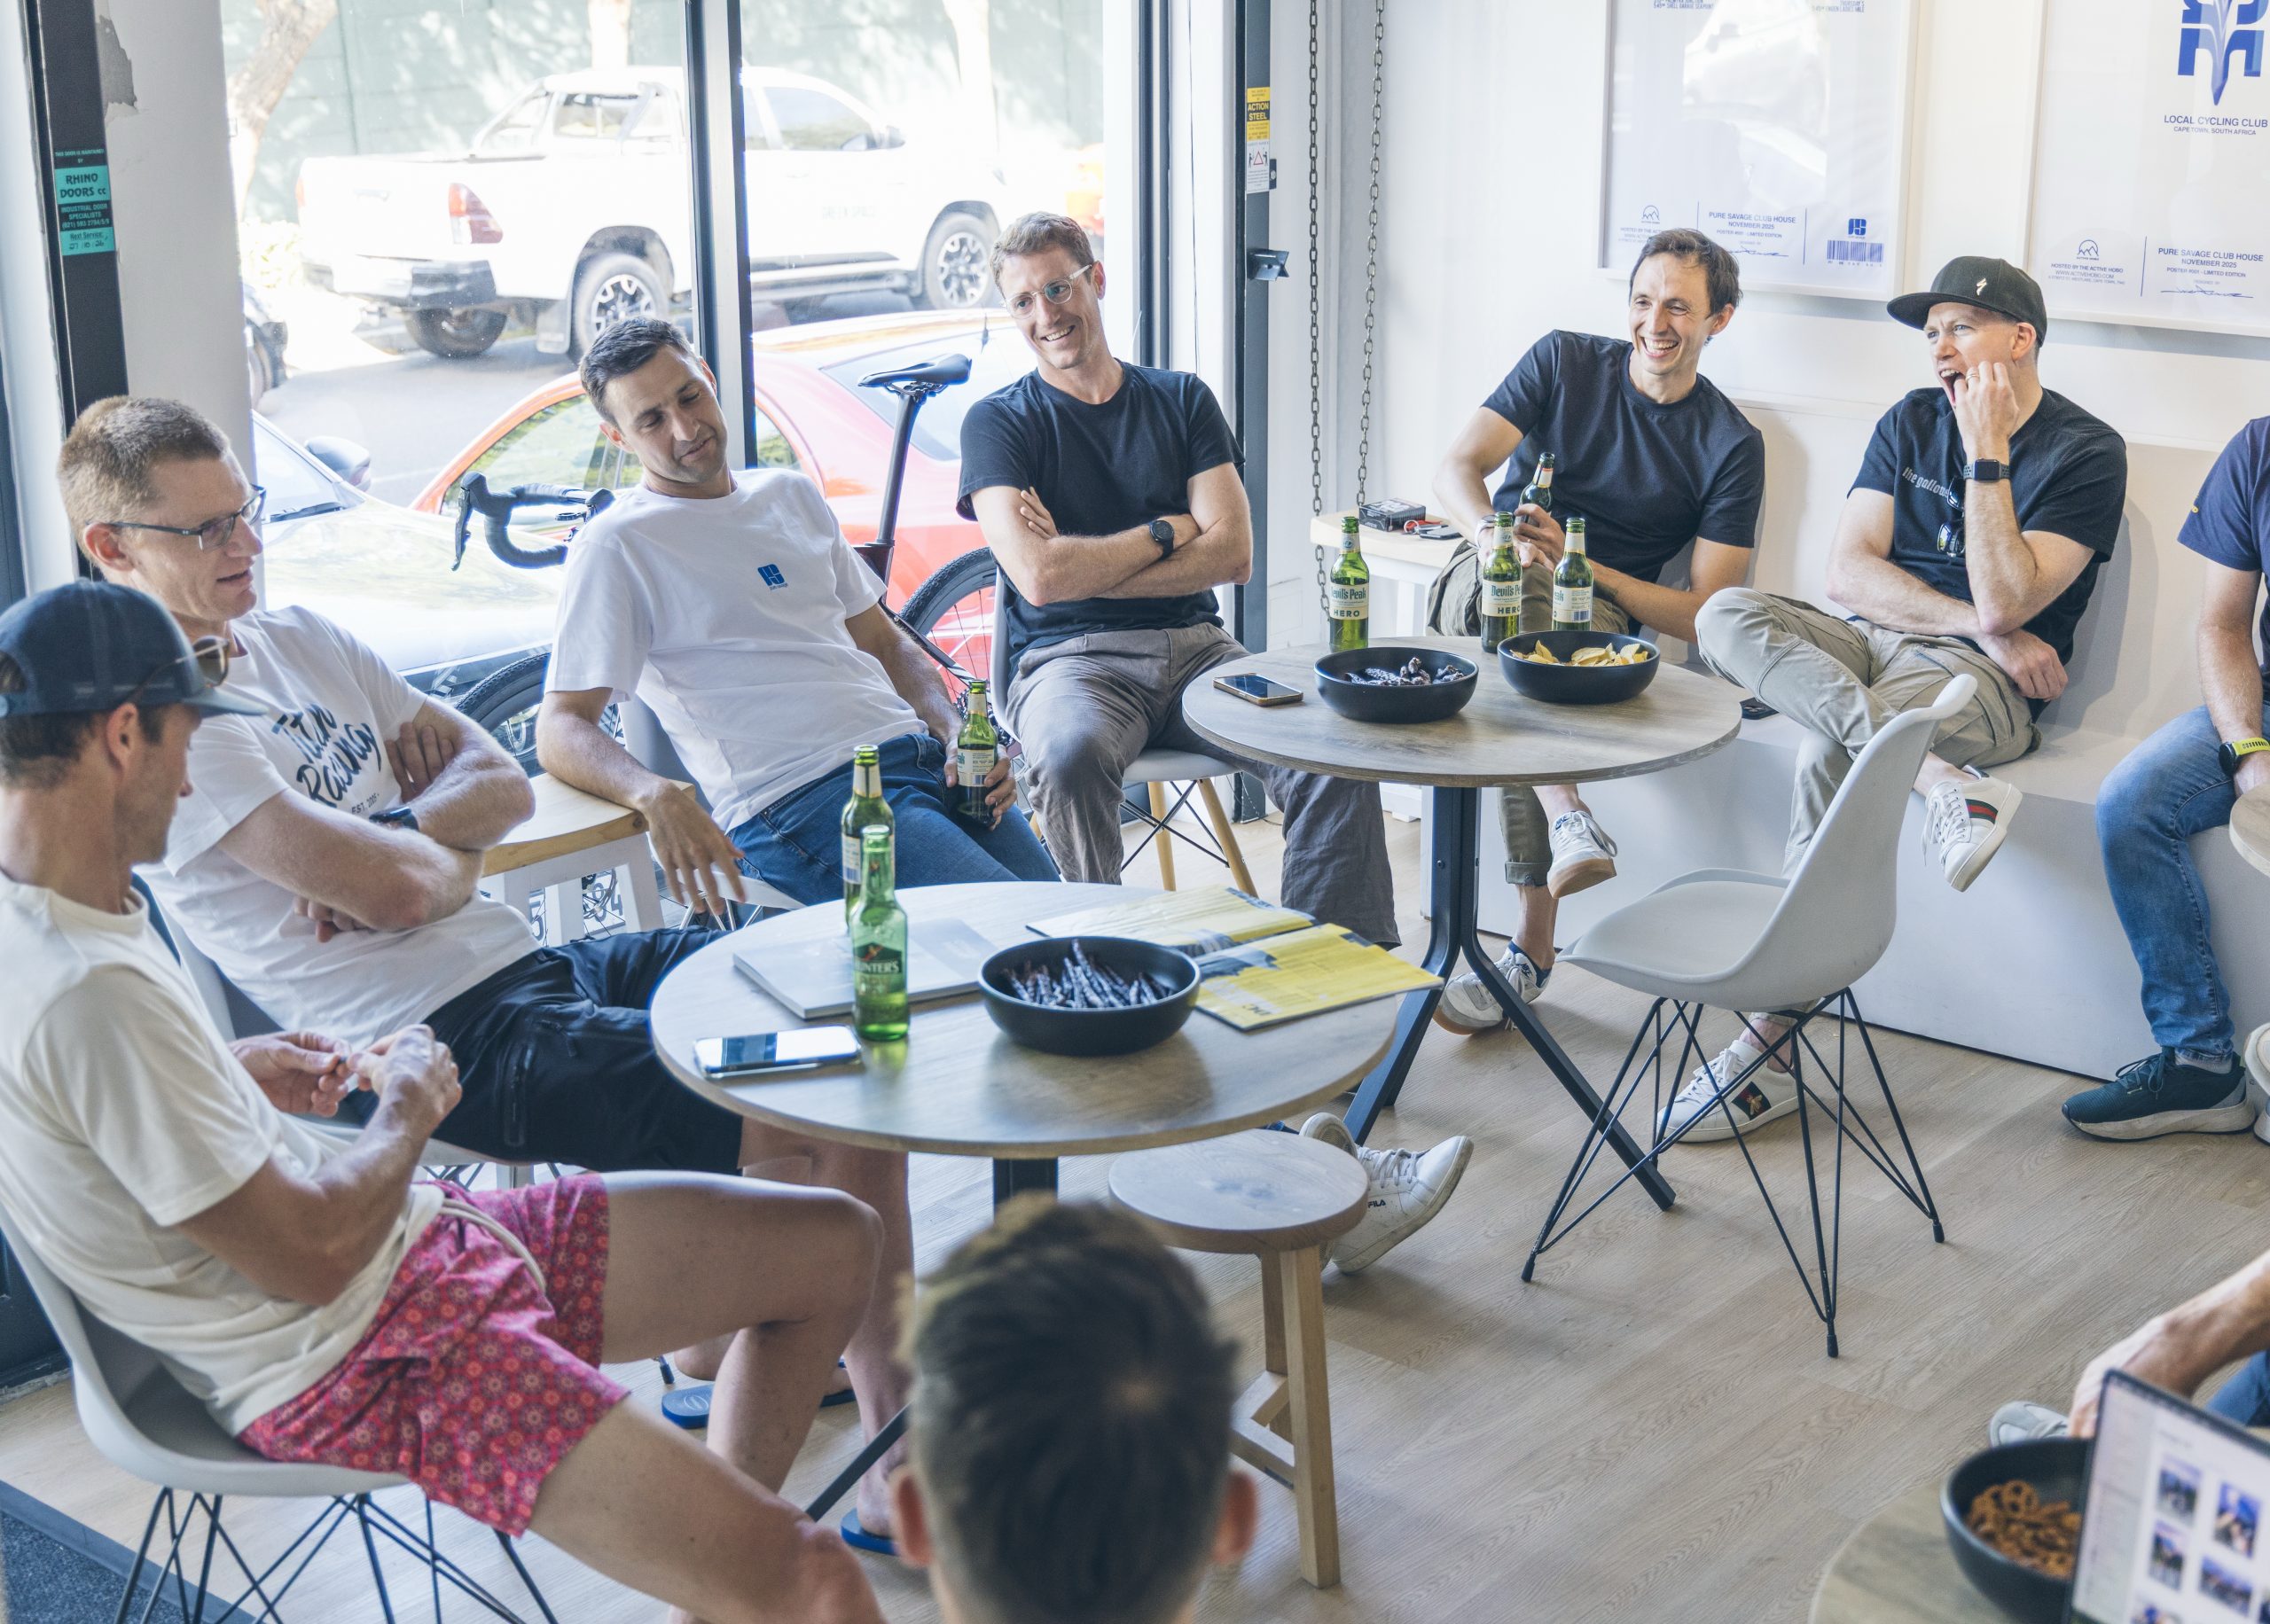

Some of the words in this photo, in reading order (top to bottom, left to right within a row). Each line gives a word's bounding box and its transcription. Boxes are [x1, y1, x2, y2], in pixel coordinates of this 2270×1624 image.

[1248, 102, 1269, 111] ACTION
[1249, 112, 1267, 121] STEEL
[2164, 115, 2194, 124] LOCAL
[2197, 116, 2239, 126] CYCLING
[2241, 118, 2268, 128] CLUB
[66, 173, 98, 185] RHINO
[60, 187, 94, 198] DOORS
[2181, 249, 2211, 258] SAVAGE
[2236, 254, 2263, 262] HOUSE
[1902, 467, 1918, 483] the
[1491, 585, 1514, 597] Devil's
[271, 703, 337, 764] Titan
[296, 722, 382, 808] Racing
[1368, 1199, 1386, 1208] FILA
